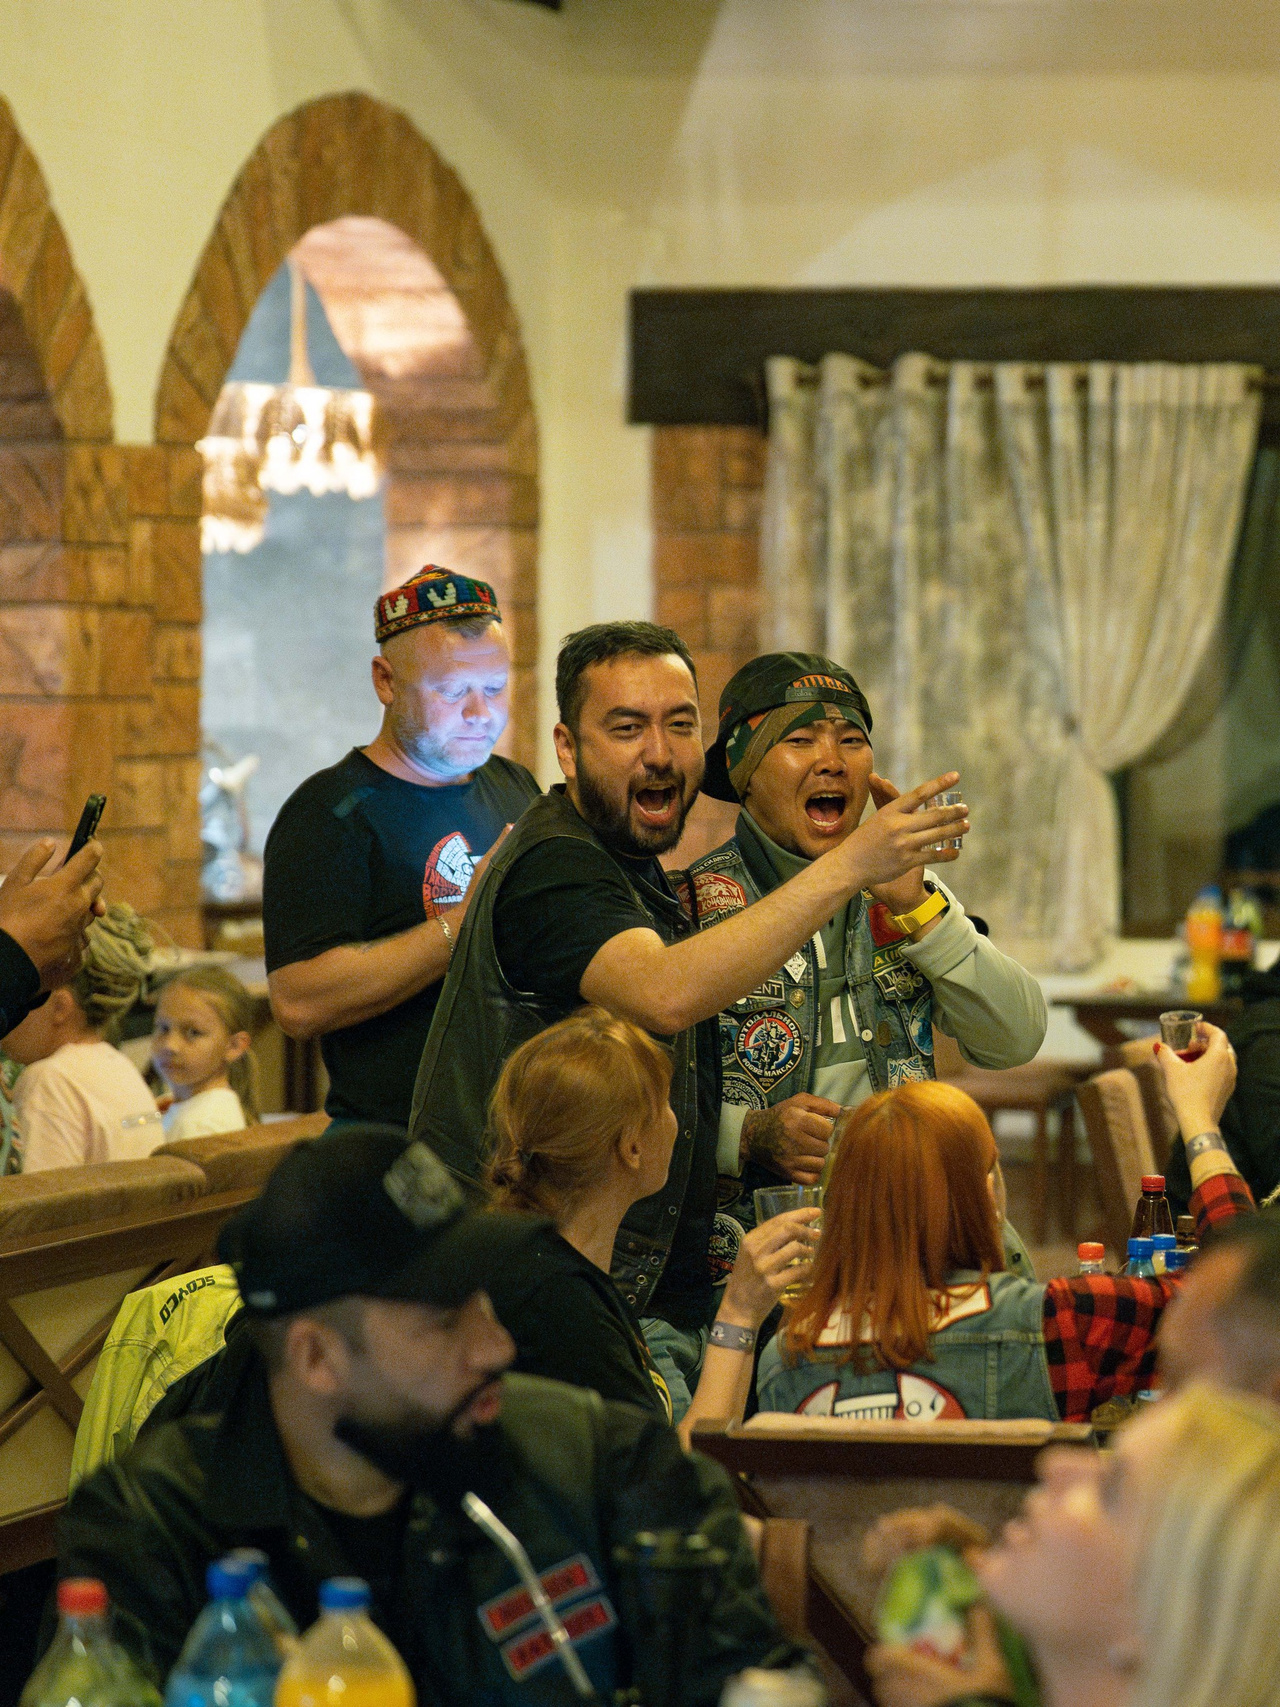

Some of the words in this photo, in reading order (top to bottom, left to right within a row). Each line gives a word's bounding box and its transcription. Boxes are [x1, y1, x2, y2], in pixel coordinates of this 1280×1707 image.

[737, 1010, 802, 1056] МОТОДАЛЬНОБОЙ
[763, 1059, 795, 1077] МАКСАТ
[159, 1275, 216, 1326] SCOYCO
